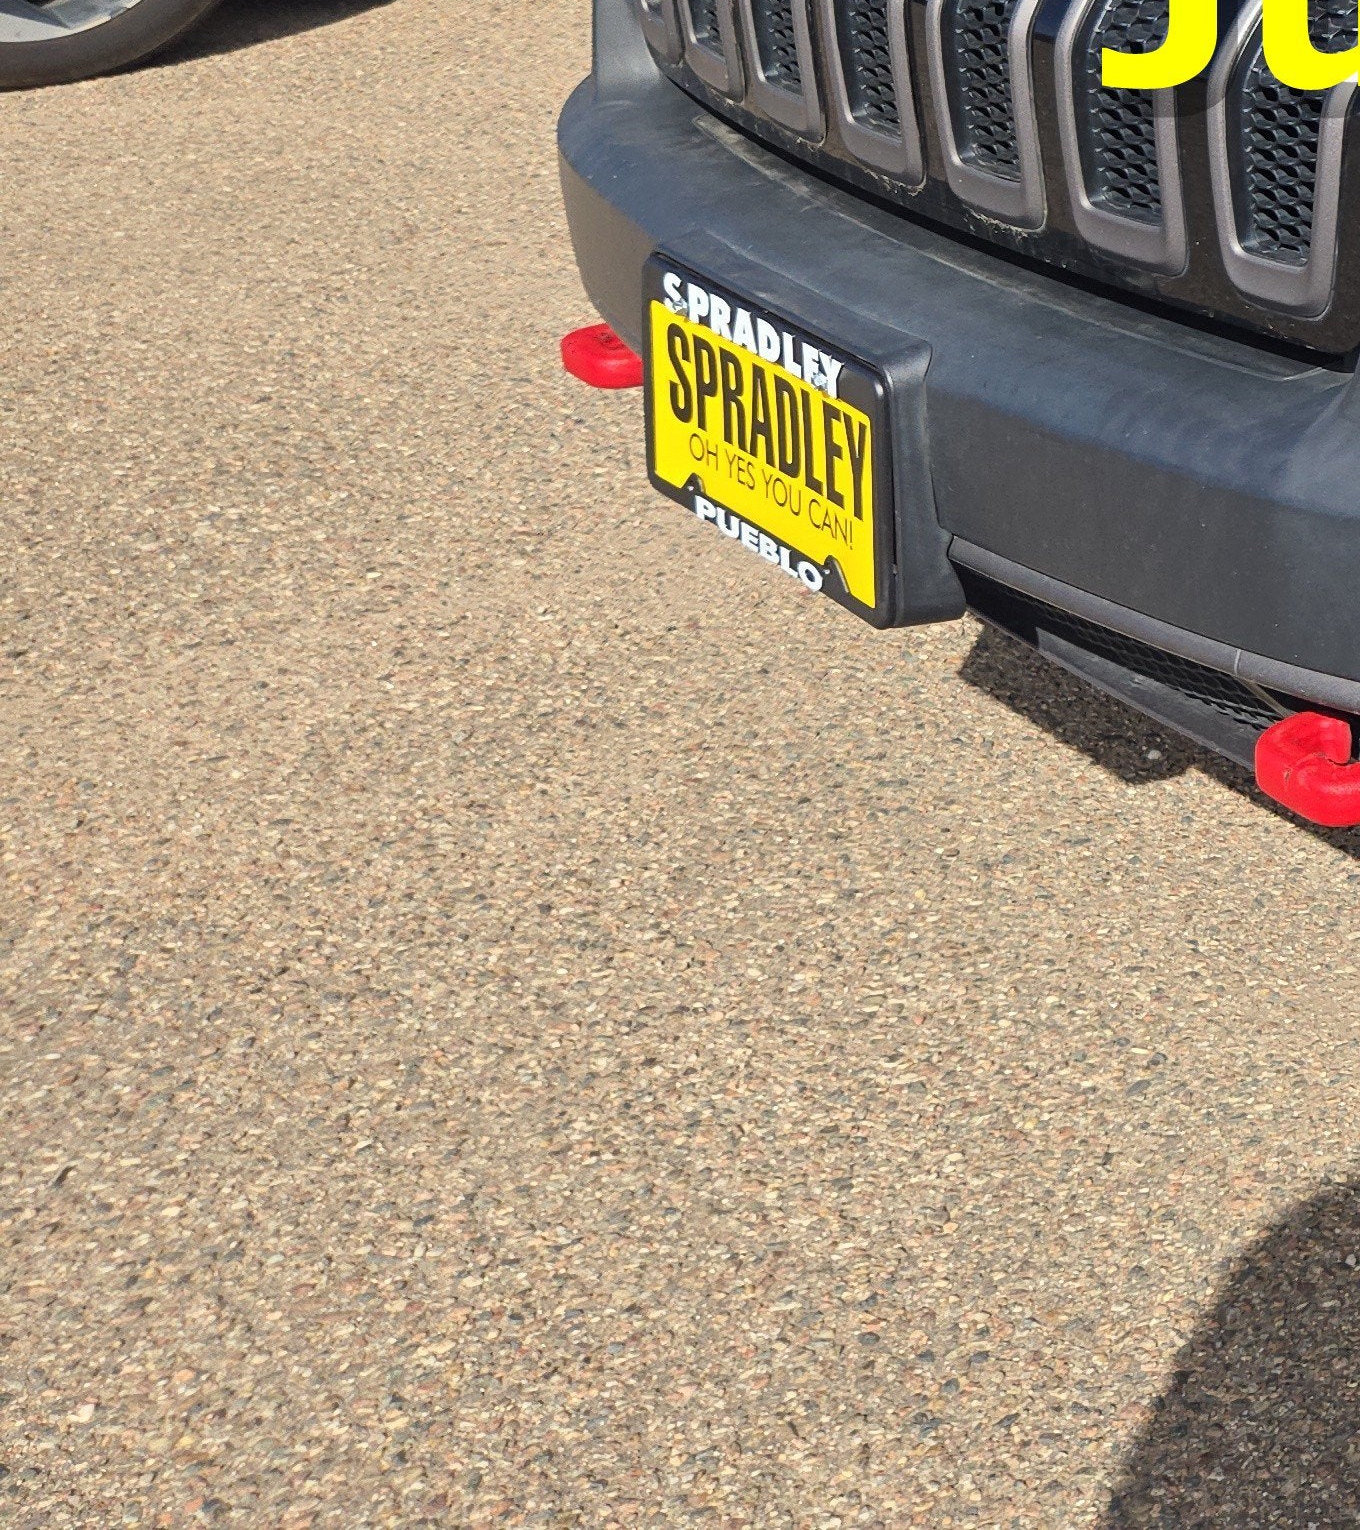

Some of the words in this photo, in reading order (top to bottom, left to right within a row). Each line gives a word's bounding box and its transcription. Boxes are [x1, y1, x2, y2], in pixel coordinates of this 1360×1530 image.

[662, 271, 846, 400] SPRADLEY
[665, 322, 868, 522] SPRADLEY
[688, 432, 719, 472] OH
[724, 443, 756, 492] YES
[760, 468, 803, 518] YOU
[808, 497, 854, 551] CAN!
[693, 494, 825, 593] PUEBLO
